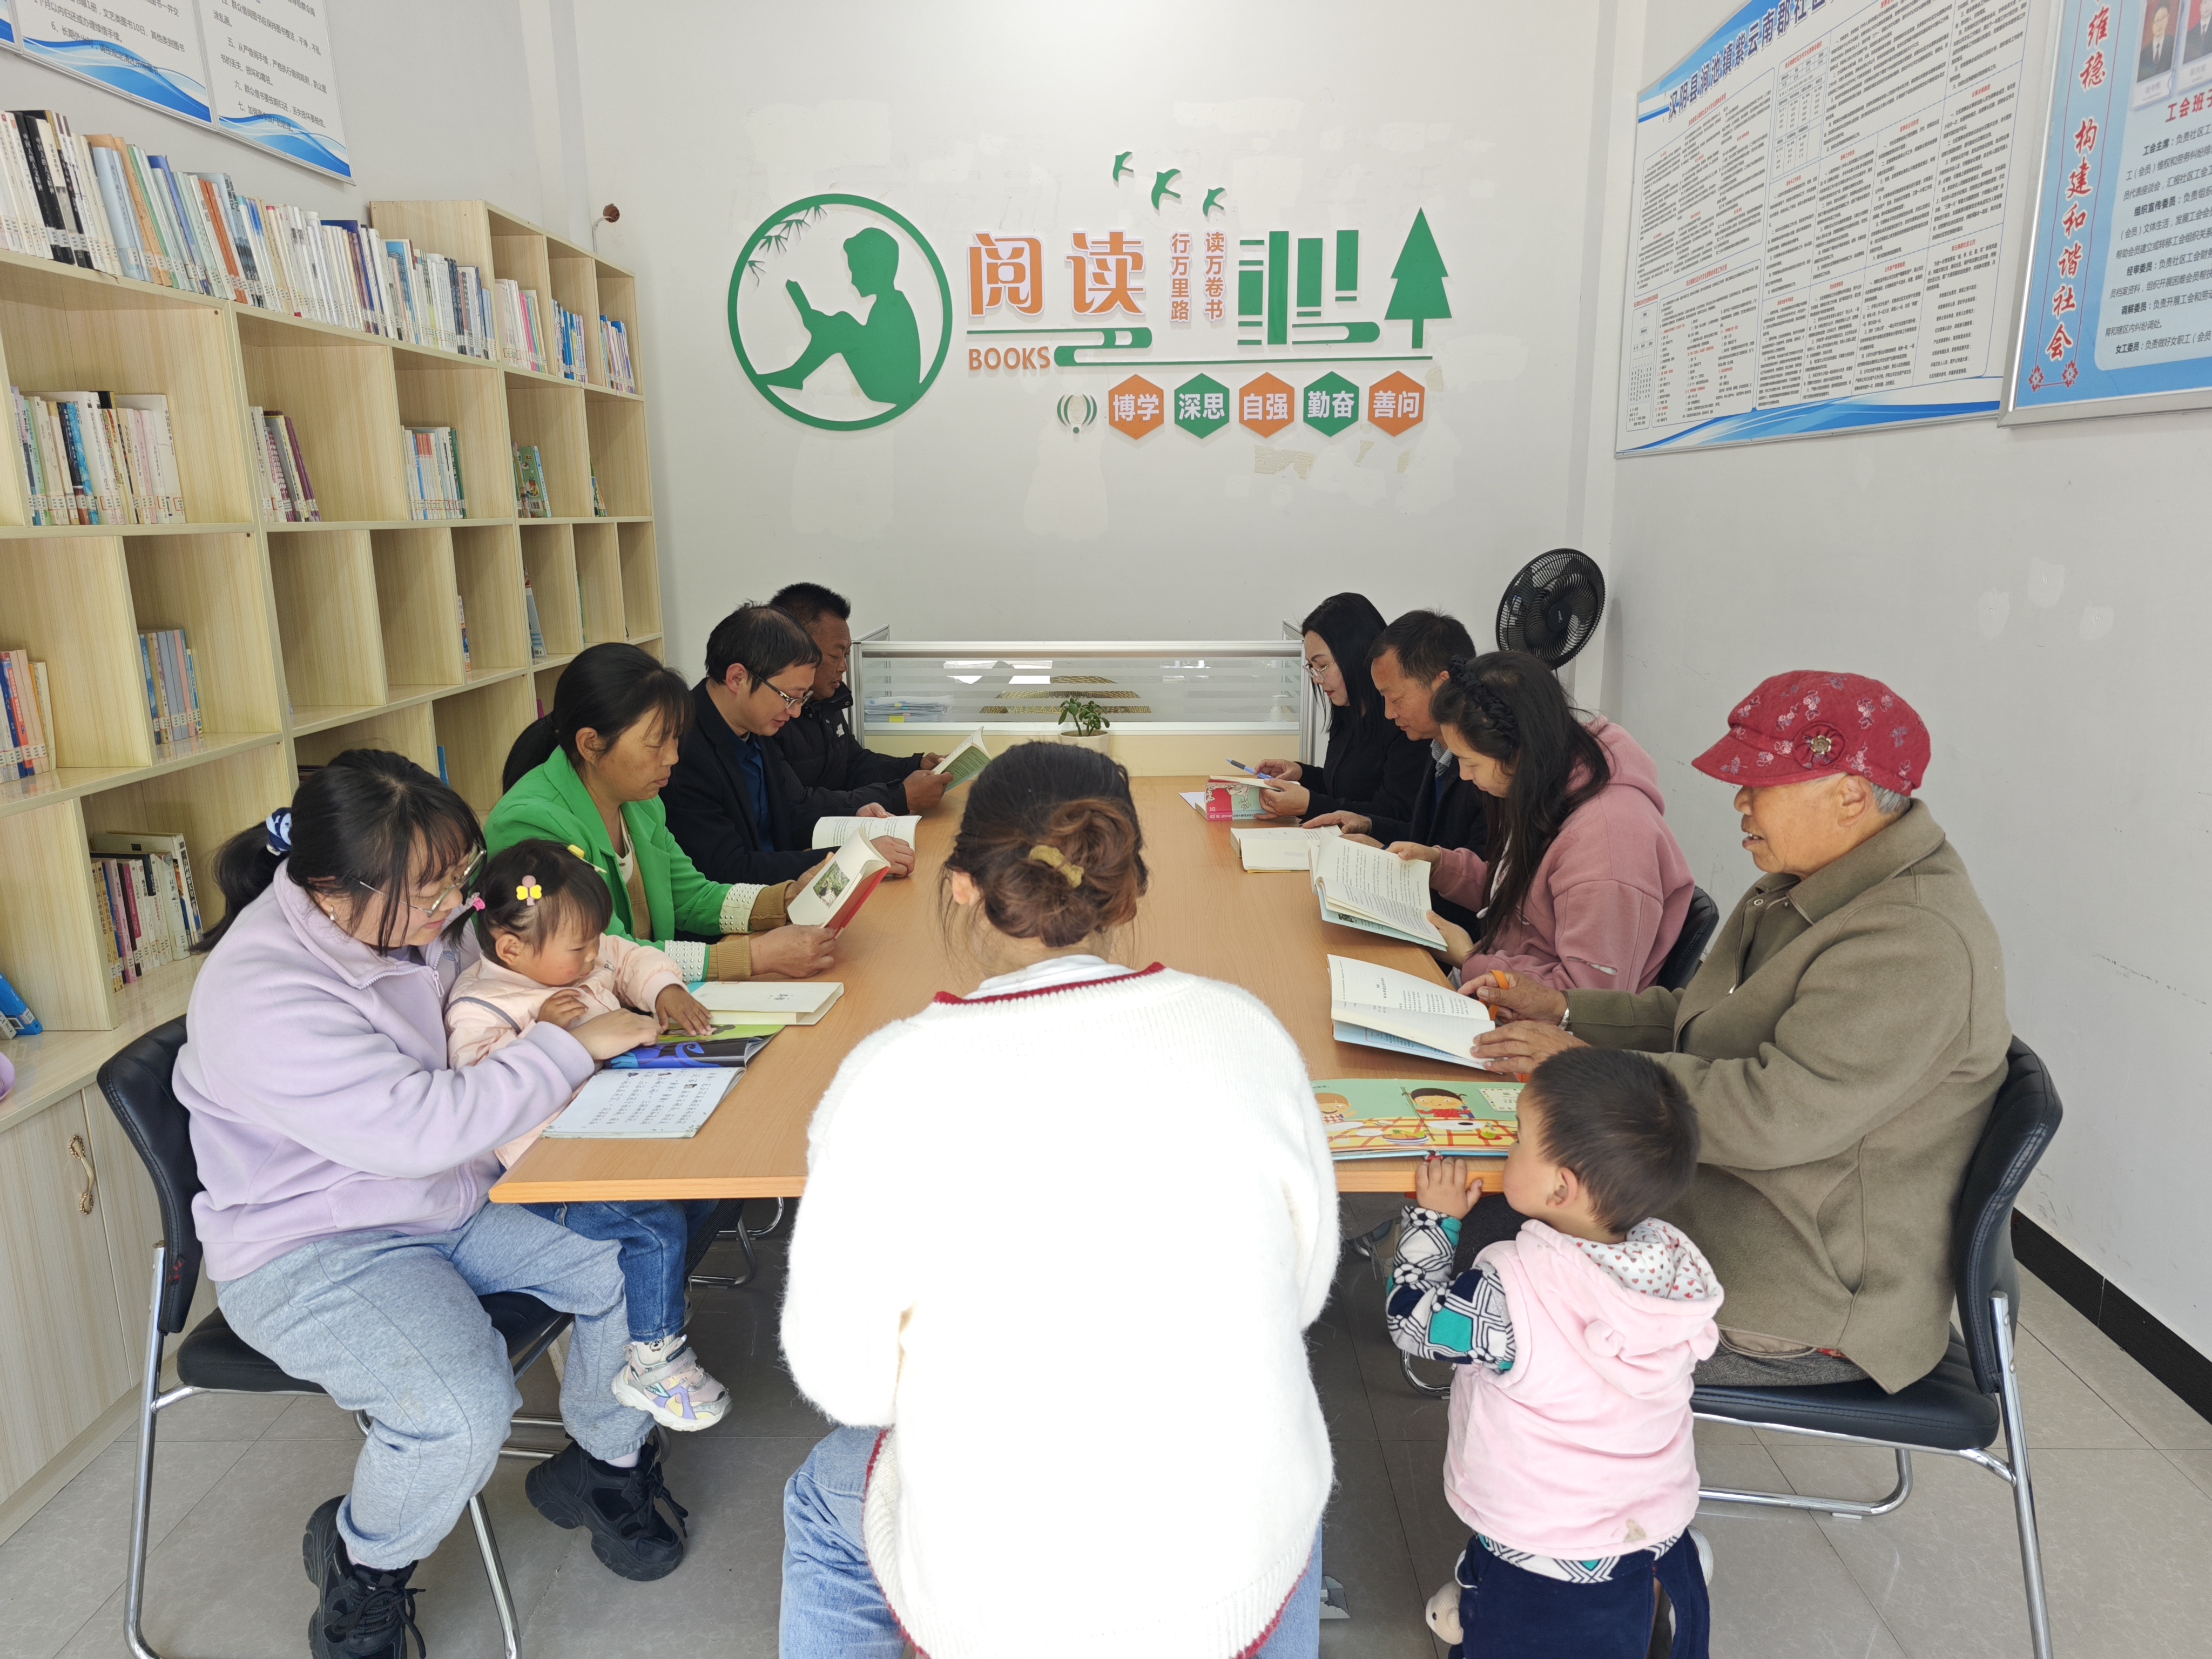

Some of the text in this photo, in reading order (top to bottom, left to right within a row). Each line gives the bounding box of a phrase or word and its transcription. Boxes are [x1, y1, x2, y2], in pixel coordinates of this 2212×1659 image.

[2126, 144, 2212, 181] 工（会员）维权和劳务纠纷排
[2142, 124, 2212, 156] 工会主席：负责社区工
[2047, 117, 2098, 361] 构建和谐社会
[970, 232, 1145, 316] 阅读
[1171, 232, 1191, 322] 行万里路
[1205, 231, 1225, 319] 读万卷书
[969, 346, 1051, 372] BOOKS
[1113, 389, 1420, 422] 博学 深思 自强 勤奋 善问
